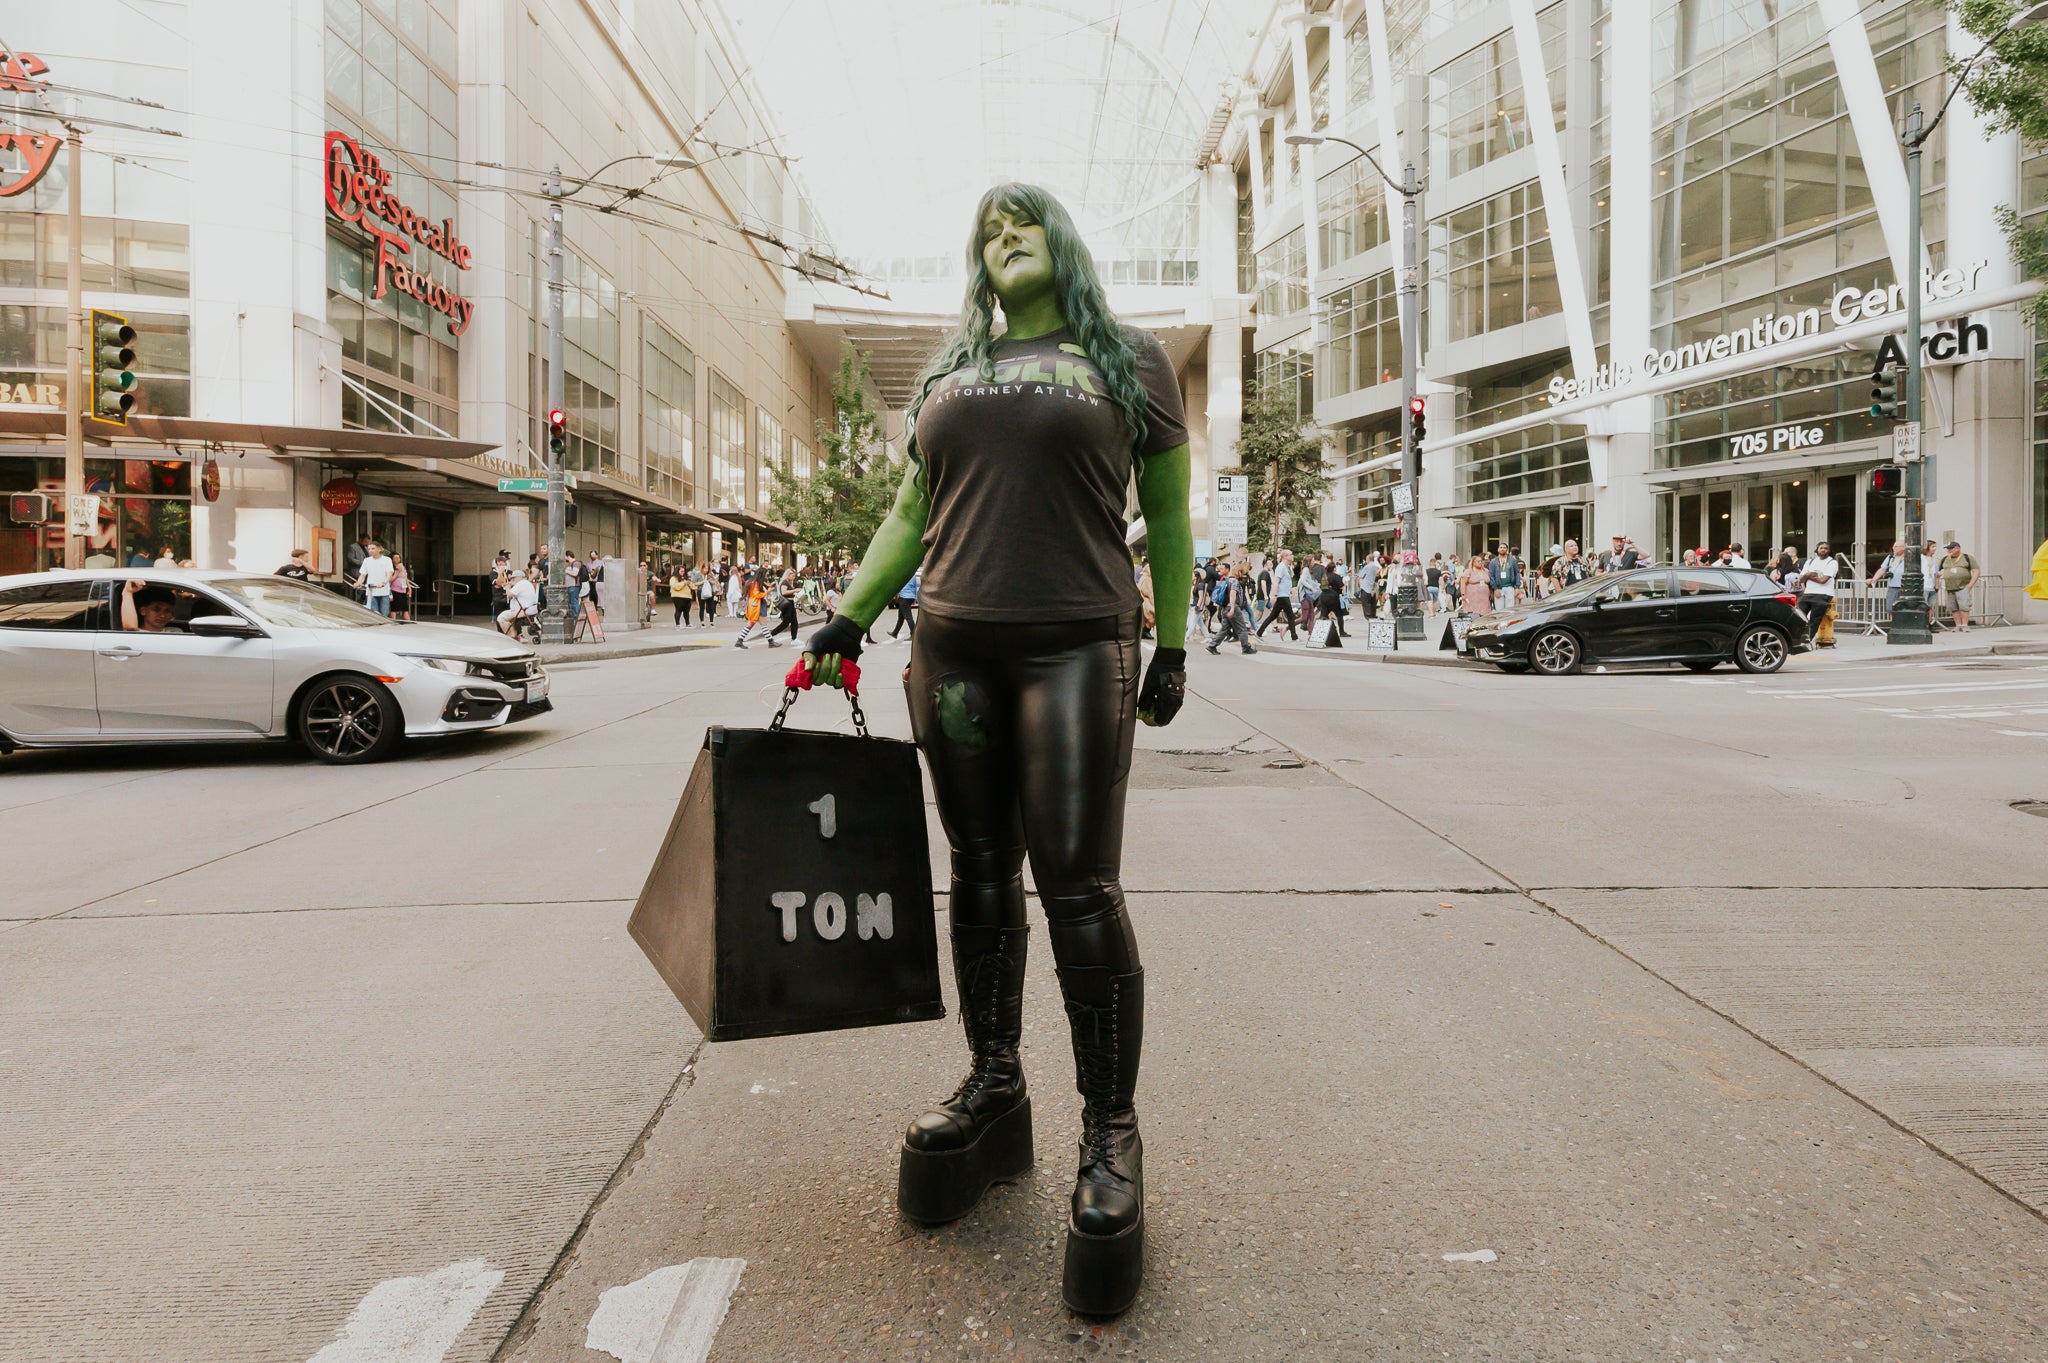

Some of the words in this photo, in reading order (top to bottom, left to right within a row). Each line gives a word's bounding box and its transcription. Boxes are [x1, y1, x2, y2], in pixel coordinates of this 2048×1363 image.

[361, 150, 393, 187] The
[324, 130, 473, 271] Cheesecake
[361, 215, 475, 337] Factory
[1547, 361, 1633, 406] Seattle
[1643, 306, 1821, 379] Convention
[1830, 258, 1988, 326] Center
[935, 384, 1023, 405] ATTORNEY
[1034, 385, 1056, 396] AT
[1065, 388, 1099, 407] LAW
[1730, 431, 1768, 458] 705
[1773, 425, 1825, 452] Pike
[1897, 426, 1917, 439] ONE
[1897, 436, 1917, 448] WAY
[530, 481, 543, 489] Ave
[73, 497, 93, 510] ONE
[1219, 496, 1246, 504] BUSES
[1222, 504, 1242, 512] ONLY
[73, 508, 94, 520] WAY
[807, 793, 837, 839] 1
[771, 891, 895, 943] TON
